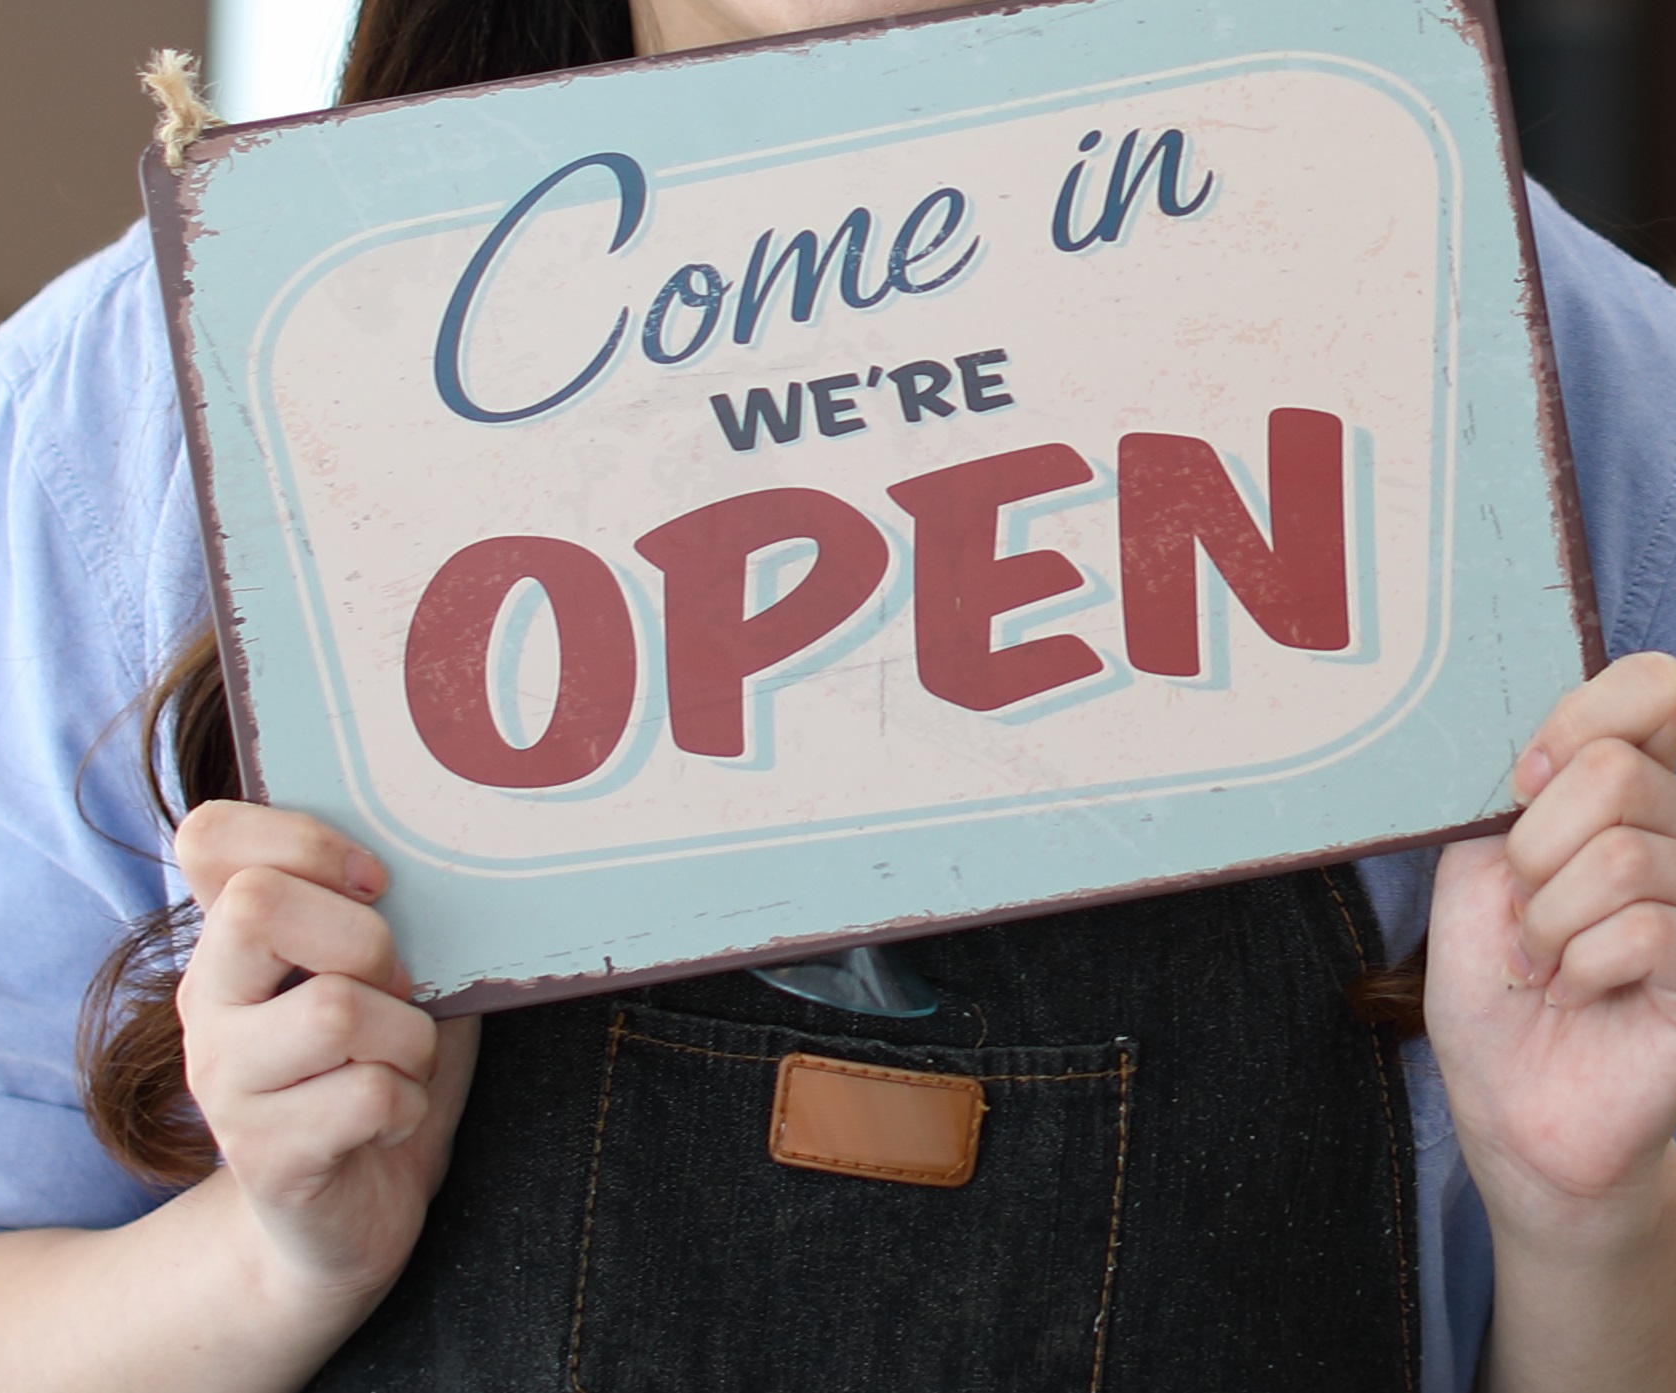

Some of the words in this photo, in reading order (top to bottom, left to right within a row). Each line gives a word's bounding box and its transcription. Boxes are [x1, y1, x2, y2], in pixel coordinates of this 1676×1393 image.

[434, 152, 980, 422] Come
[1052, 128, 1213, 252] in
[709, 349, 1014, 451] WE'RE
[404, 407, 1351, 788] OPEN
